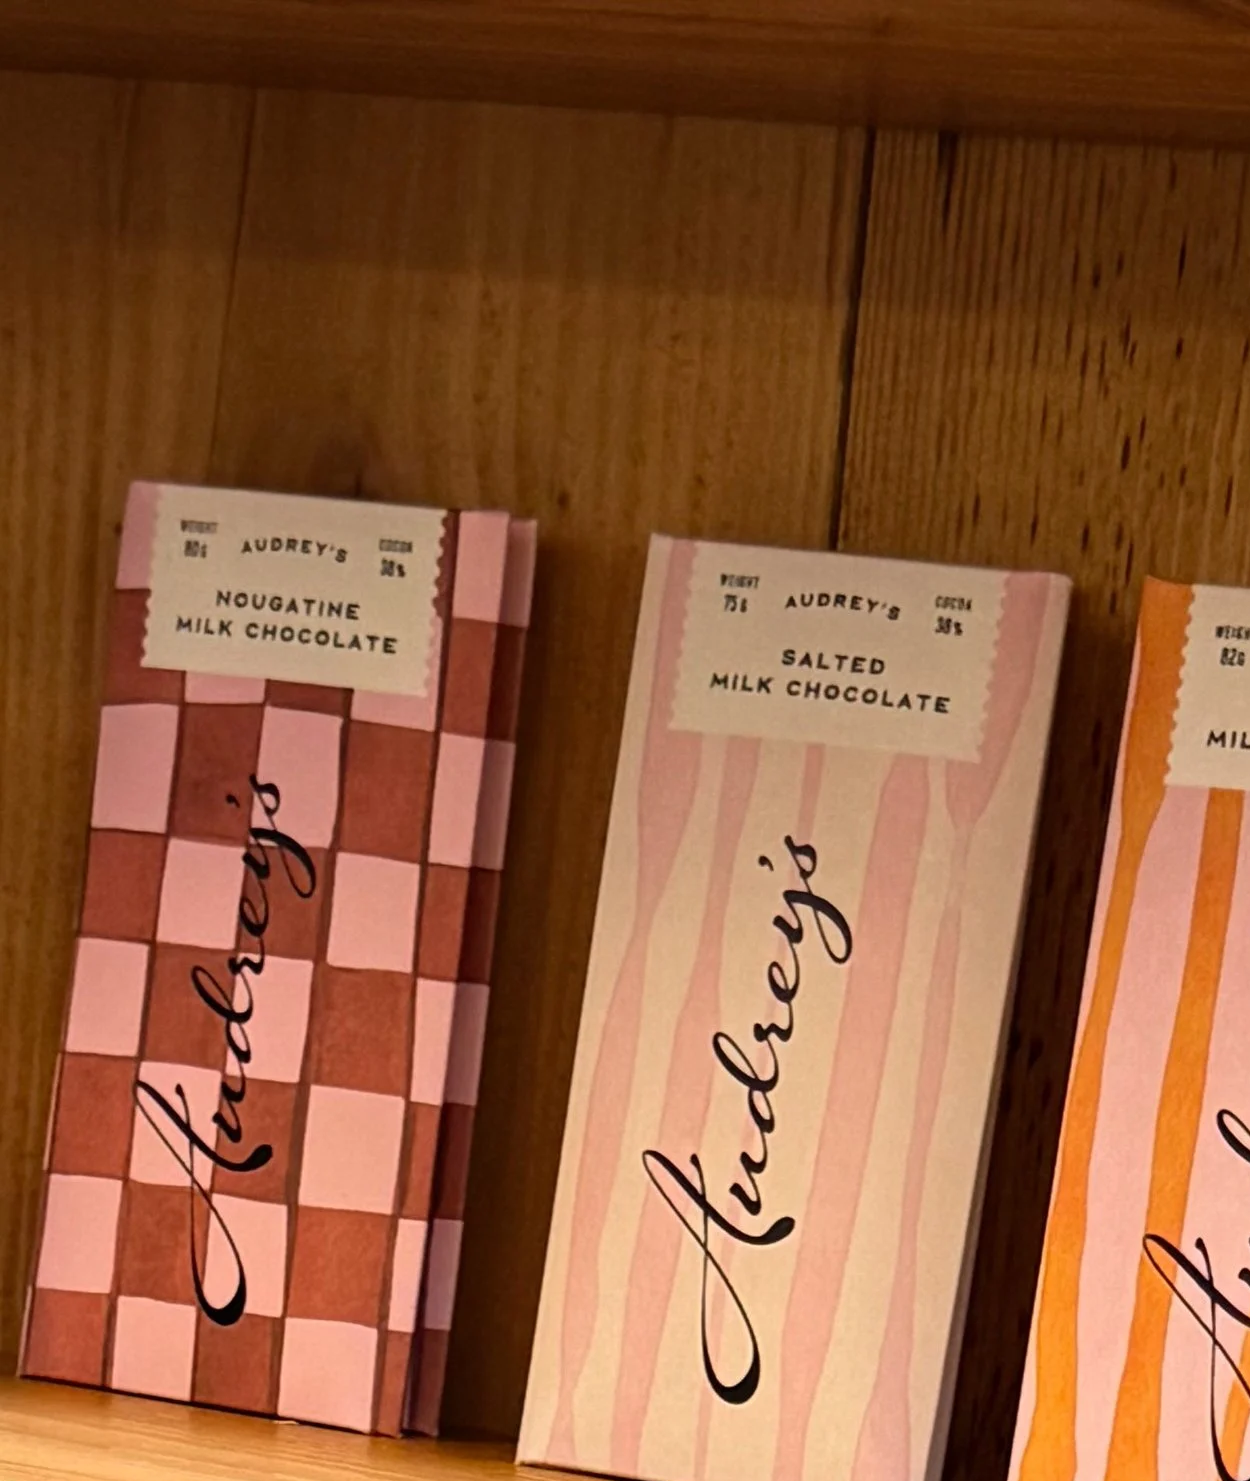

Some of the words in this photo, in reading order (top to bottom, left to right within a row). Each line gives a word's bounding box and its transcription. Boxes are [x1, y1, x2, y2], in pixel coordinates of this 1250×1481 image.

[241, 537, 348, 564] AUDREY'S
[215, 589, 362, 622] NOUGATINE
[784, 592, 901, 621] AUDREY'S
[175, 615, 234, 639] MILK
[245, 622, 399, 656] CHOCOLATE
[781, 648, 887, 676] SALTED
[709, 672, 774, 695] MILK
[786, 679, 951, 715] CHOCOLATE
[134, 773, 317, 1327] Audrey's
[641, 834, 853, 1405] Audrey's
